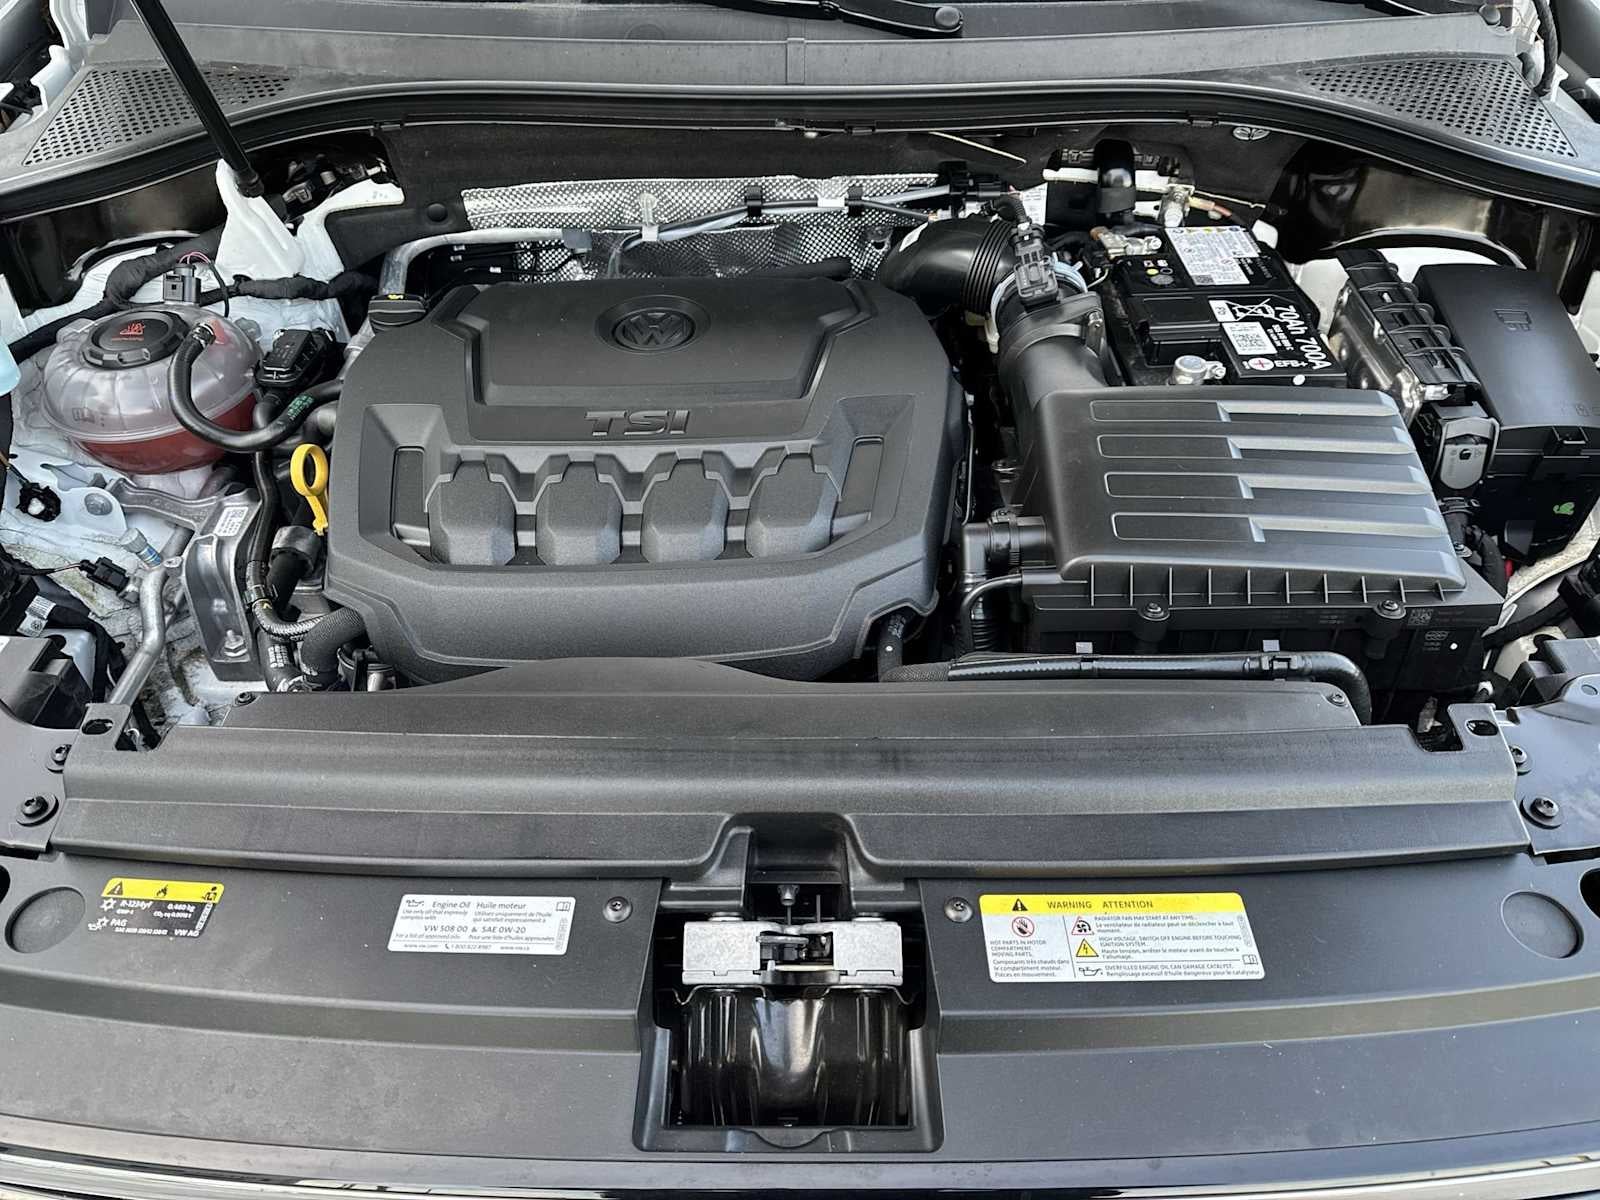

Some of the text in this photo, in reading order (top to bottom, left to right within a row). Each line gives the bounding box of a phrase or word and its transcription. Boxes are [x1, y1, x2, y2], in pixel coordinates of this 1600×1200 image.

[1275, 305, 1308, 335] 70Ah
[1295, 337, 1332, 369] 700A
[584, 409, 690, 436] TSI
[1047, 901, 1092, 909] WARNING
[1102, 900, 1154, 908] ATTENTION
[110, 918, 128, 927] PAG
